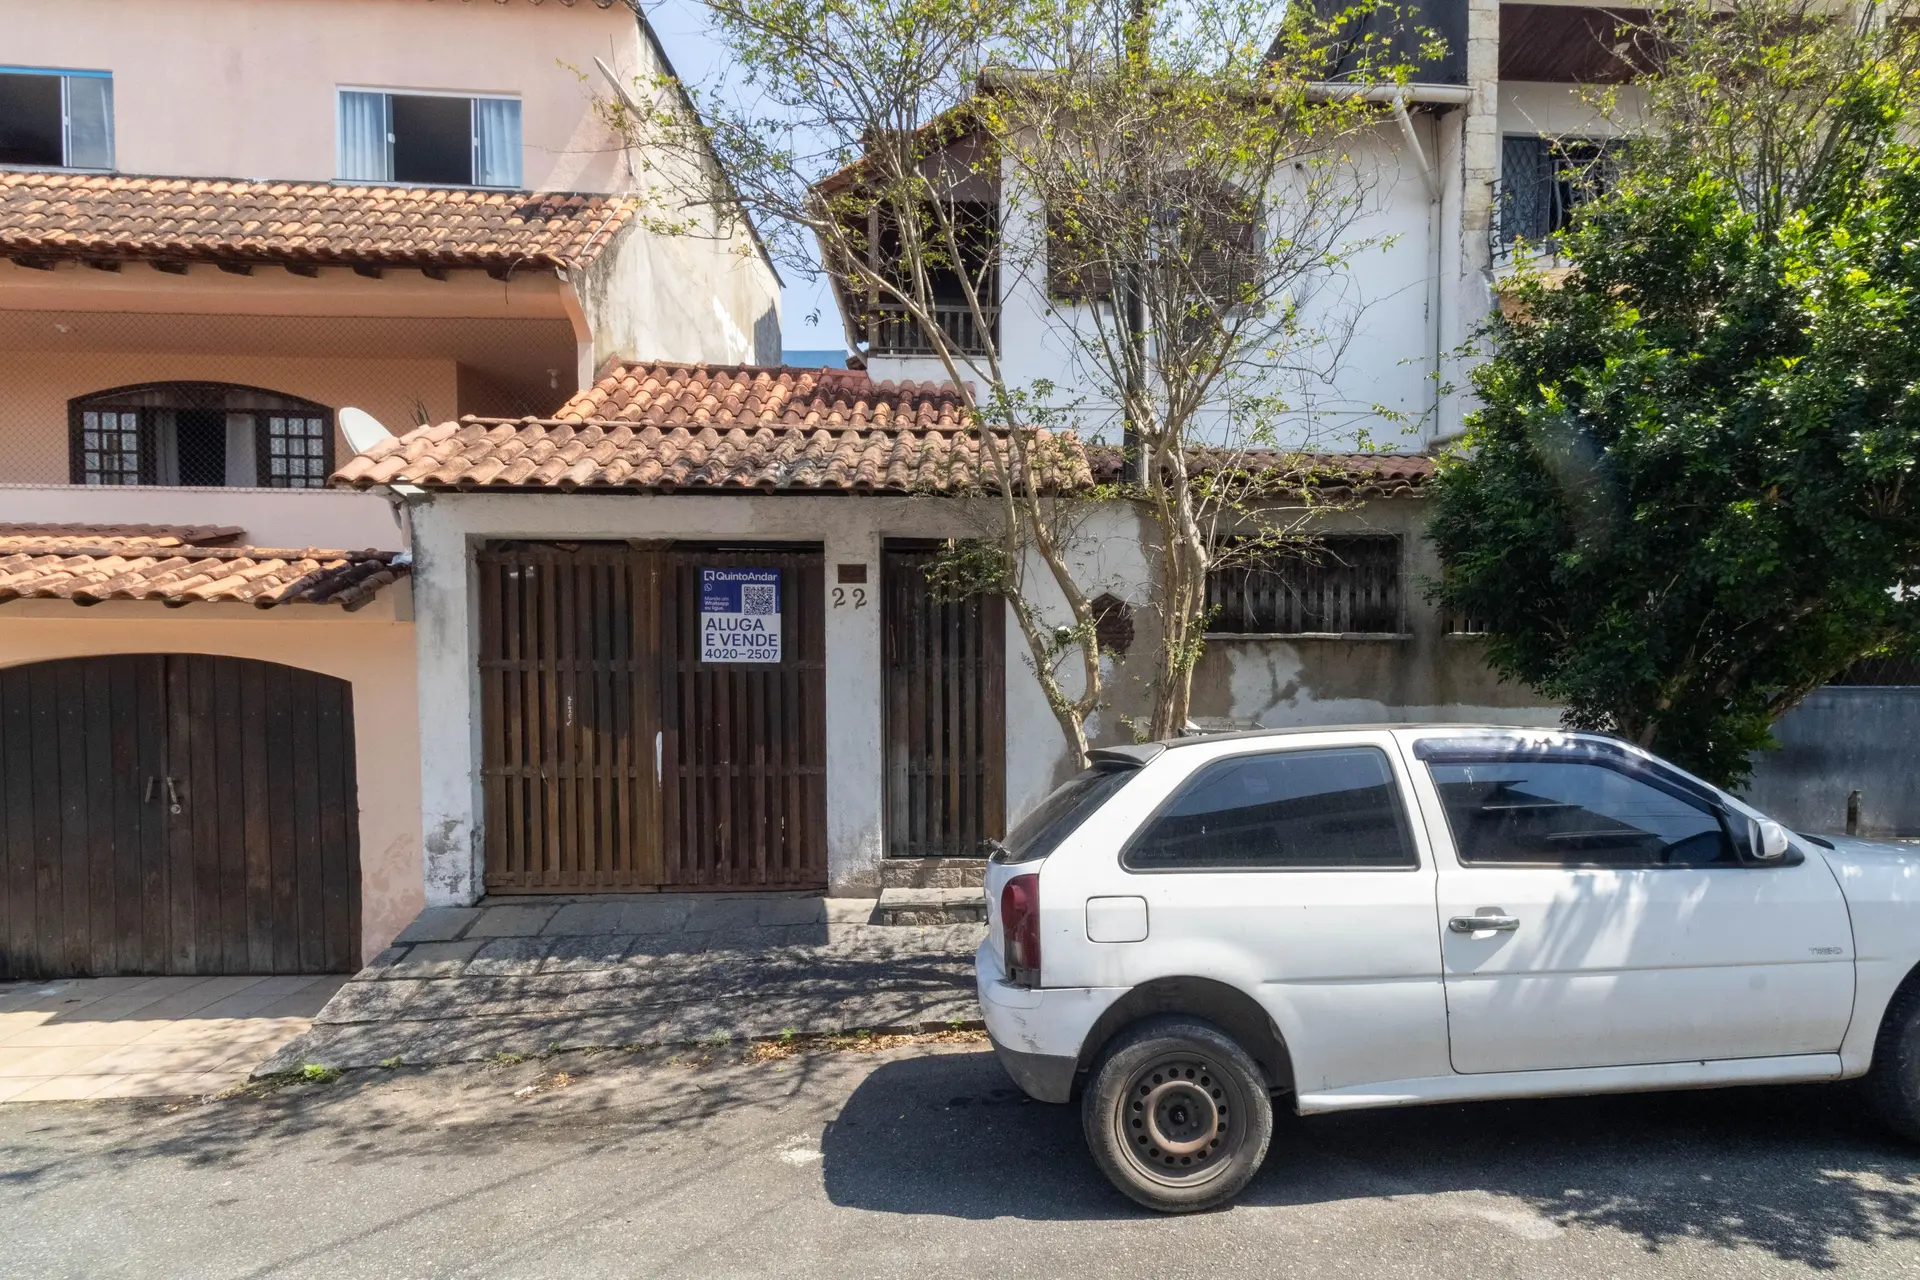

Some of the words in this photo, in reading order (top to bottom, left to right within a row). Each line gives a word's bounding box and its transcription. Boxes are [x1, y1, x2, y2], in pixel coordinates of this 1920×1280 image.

[716, 571, 778, 581] QuintoAndar
[831, 587, 867, 610] 22
[705, 617, 765, 632] ALUGA
[706, 633, 715, 647] E
[719, 633, 778, 647] VENDE
[705, 648, 778, 660] 4020-2507
